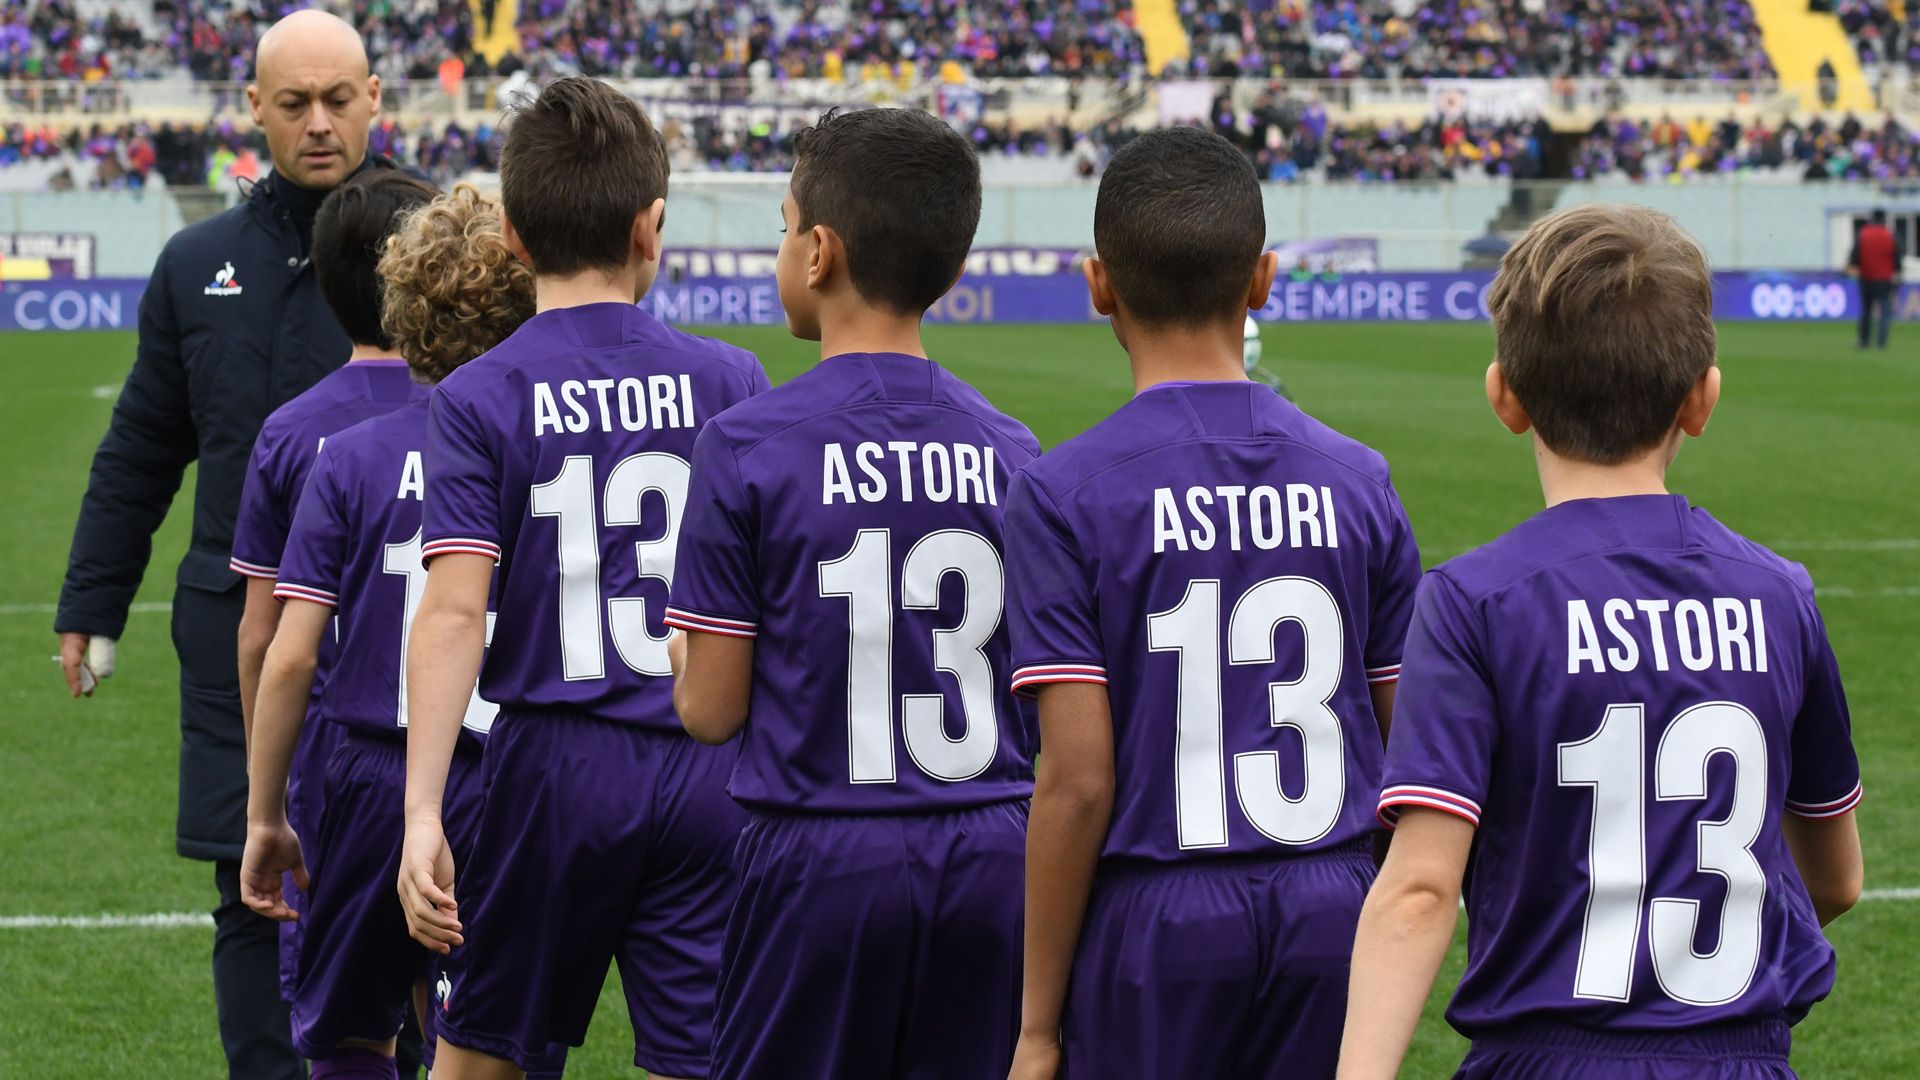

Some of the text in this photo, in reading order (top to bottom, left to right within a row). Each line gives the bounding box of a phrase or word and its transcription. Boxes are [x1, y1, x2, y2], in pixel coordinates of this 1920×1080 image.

[14, 290, 121, 331] CON
[1259, 281, 1431, 322] SEMPRE
[1751, 283, 1847, 318] 00:00
[534, 375, 694, 436] ASTORI
[823, 442, 997, 506] ASTORI
[1154, 484, 1338, 553] ASTORI
[818, 528, 1004, 784] 13
[1568, 598, 1767, 673] ASTORI
[1147, 576, 1345, 850] 13
[1558, 701, 1767, 1006] 13
